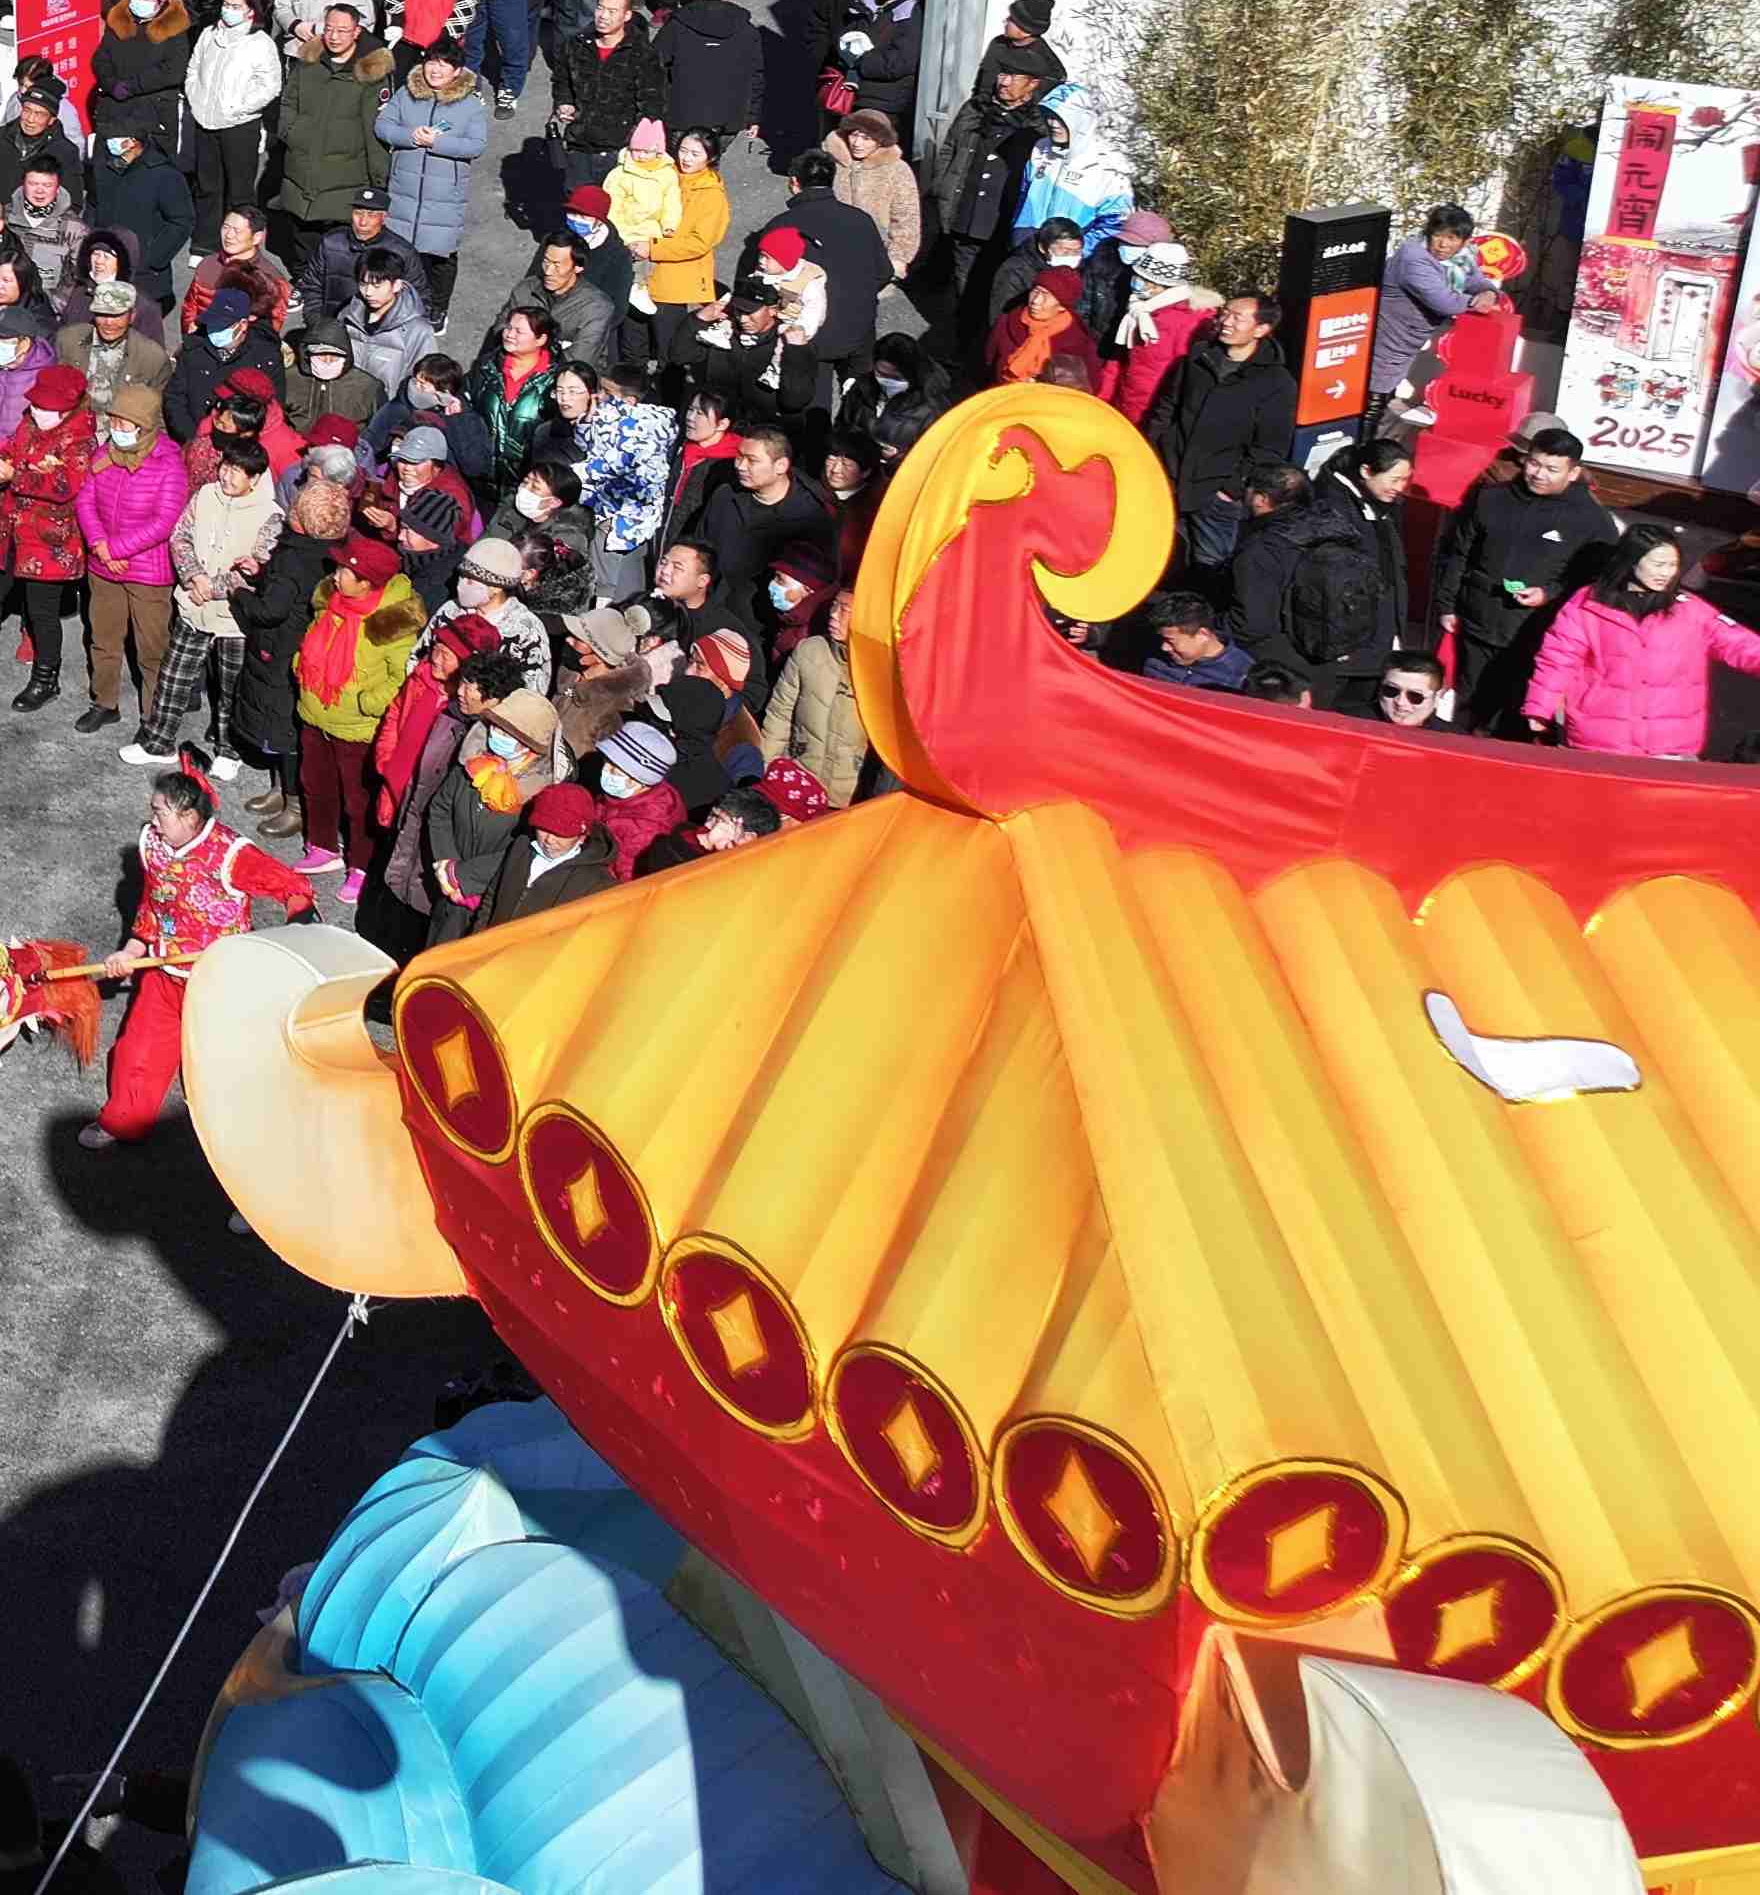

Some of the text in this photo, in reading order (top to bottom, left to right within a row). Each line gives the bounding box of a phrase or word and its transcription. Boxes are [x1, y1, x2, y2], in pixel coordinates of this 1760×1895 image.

[1616, 122, 1667, 236] 闹元宵
[1448, 384, 1506, 410] Lucky
[1587, 415, 1695, 457] 2025
